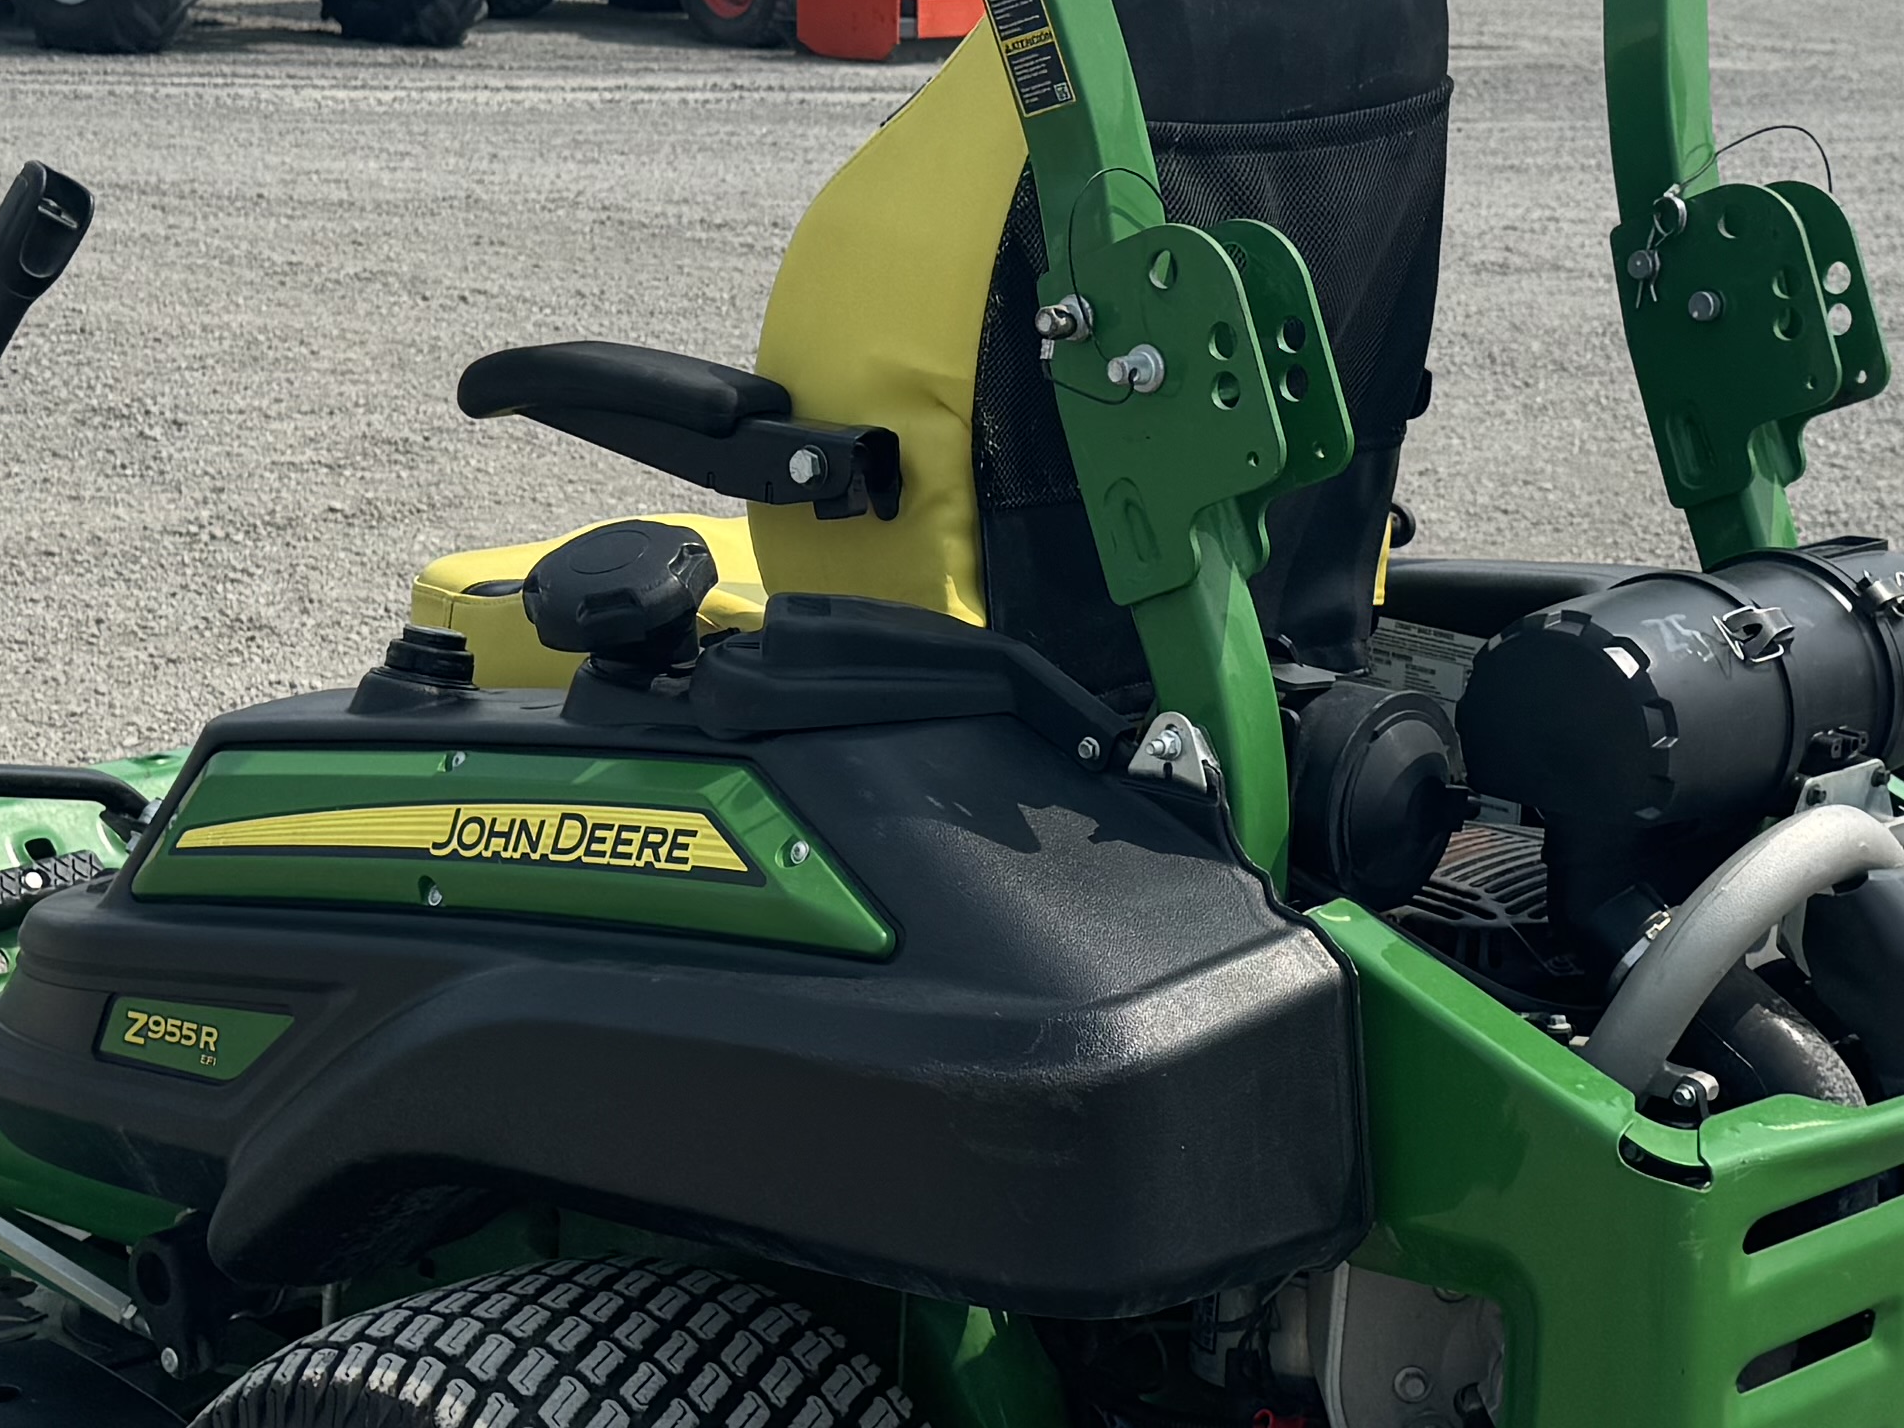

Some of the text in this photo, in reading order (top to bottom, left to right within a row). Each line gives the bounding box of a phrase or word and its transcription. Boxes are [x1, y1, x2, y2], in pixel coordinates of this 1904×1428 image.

[430, 807, 698, 865] JOHN DEERE
[199, 1054, 216, 1067] EFI
